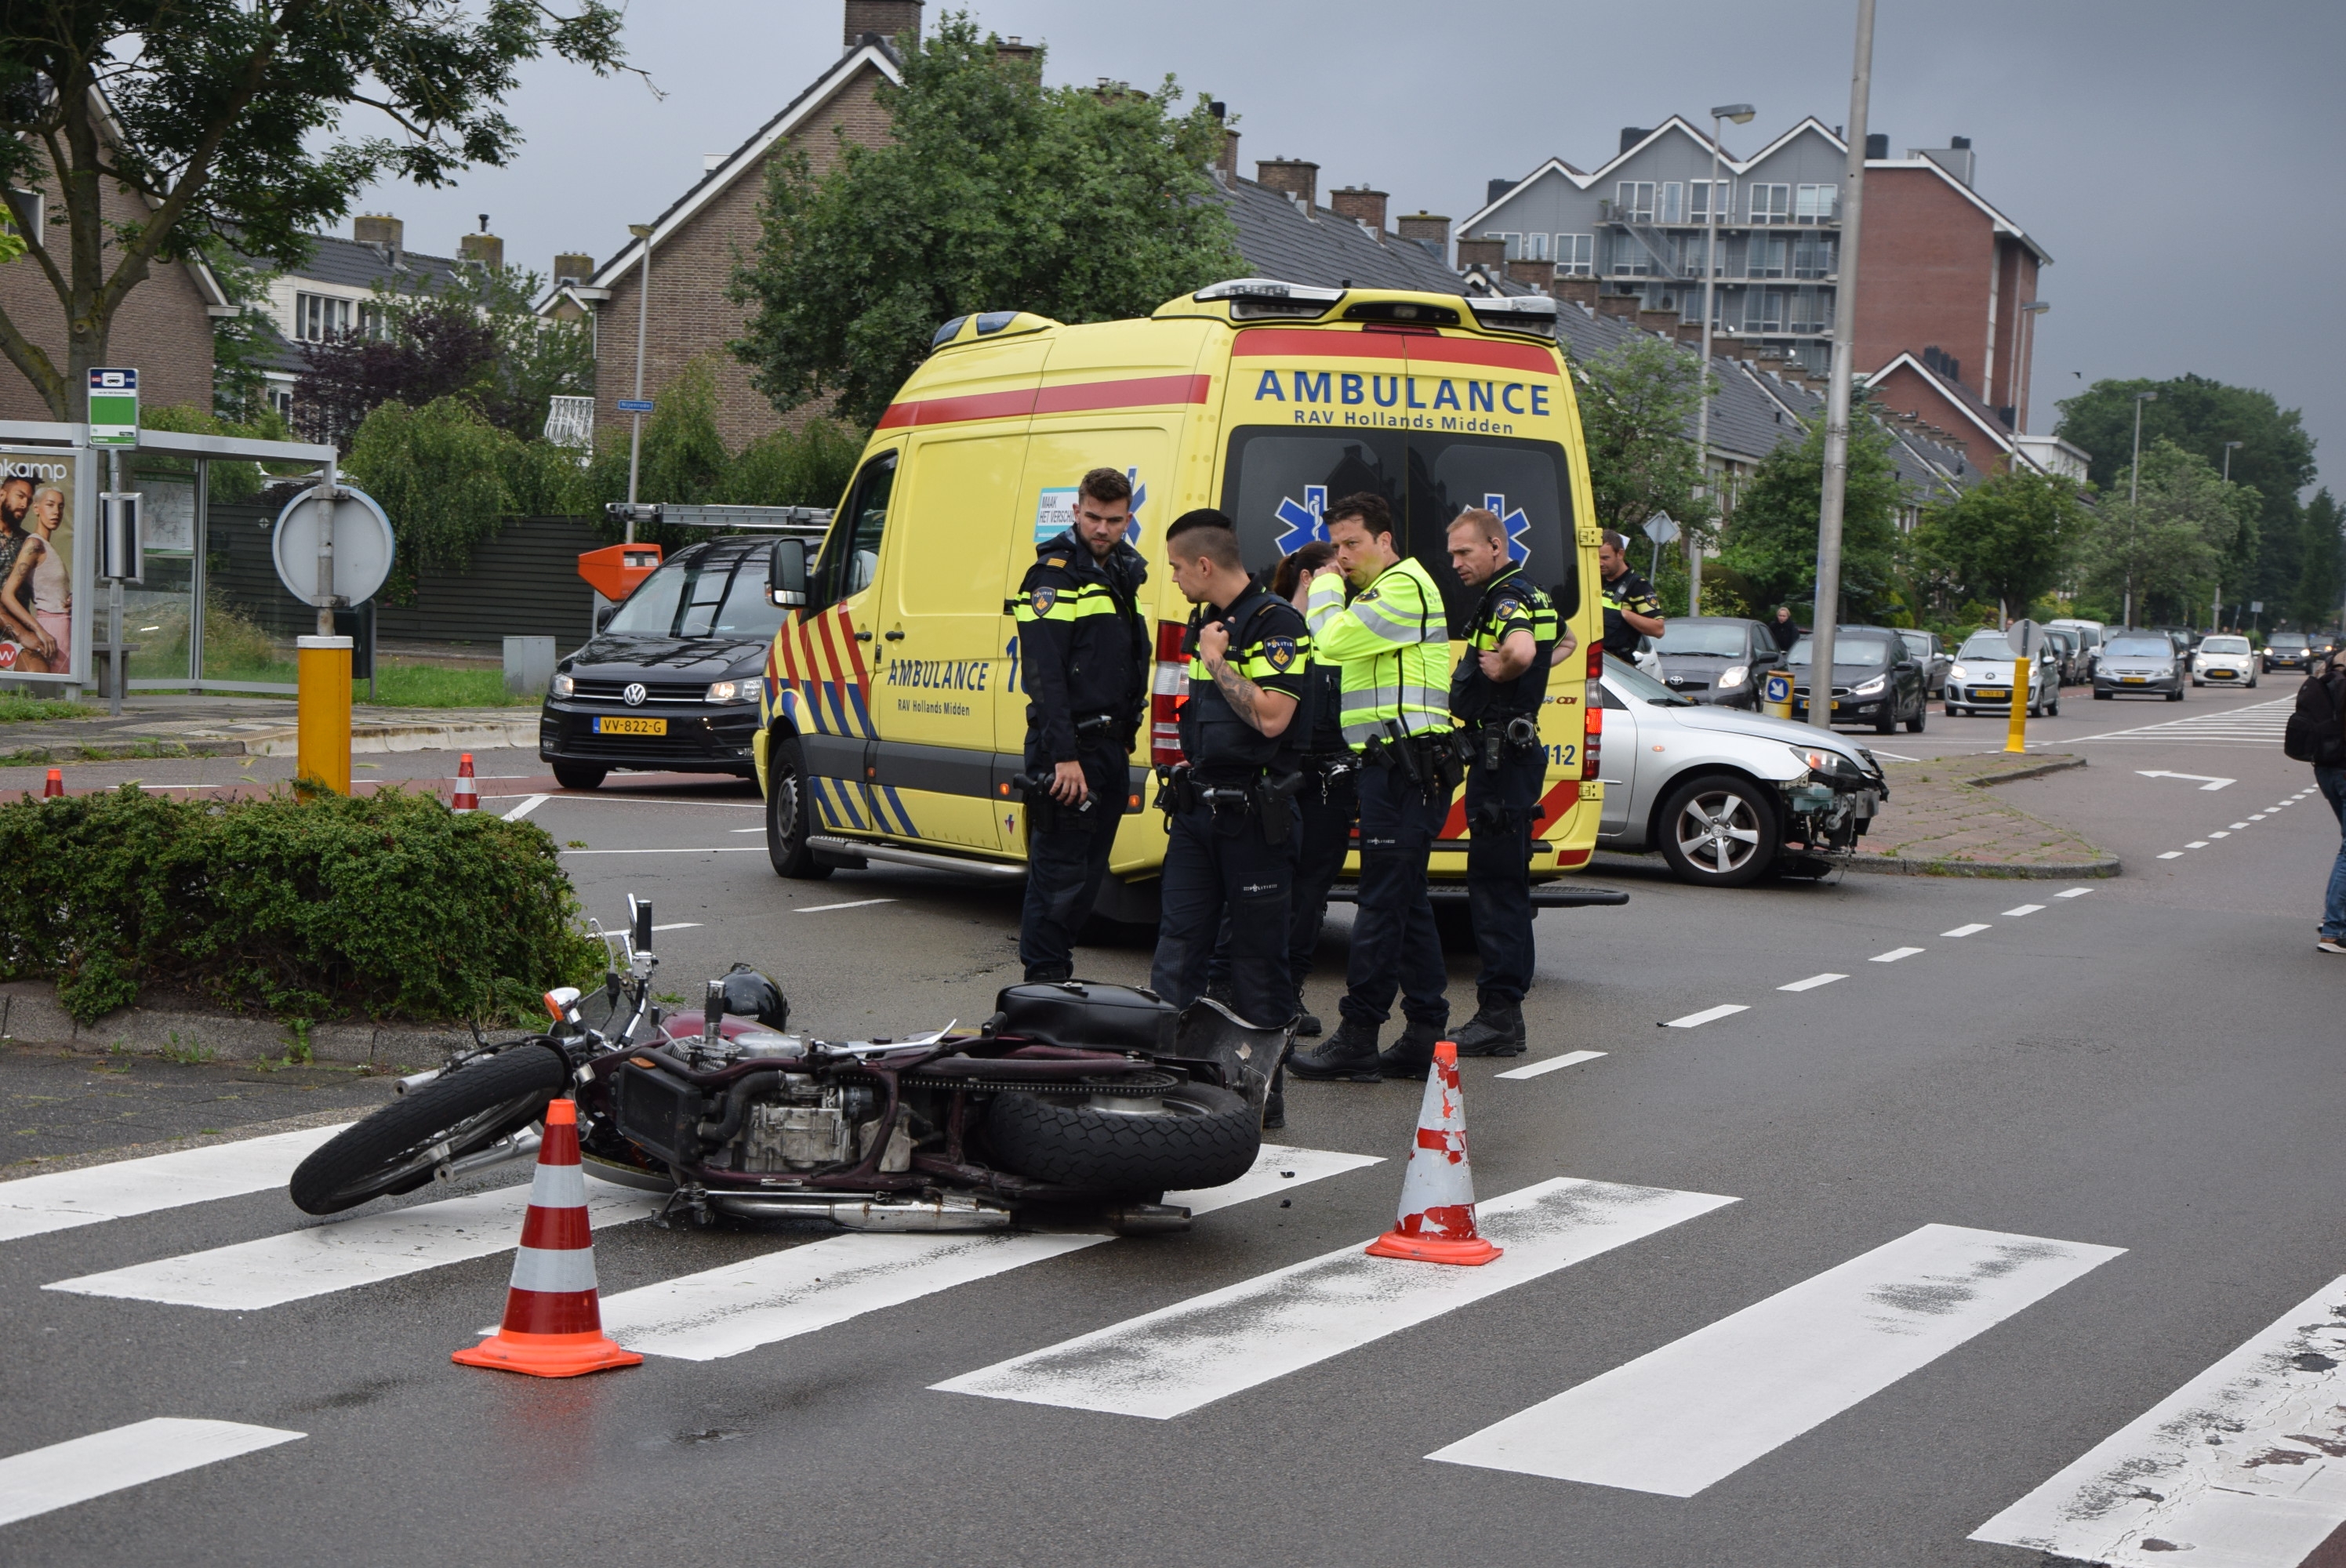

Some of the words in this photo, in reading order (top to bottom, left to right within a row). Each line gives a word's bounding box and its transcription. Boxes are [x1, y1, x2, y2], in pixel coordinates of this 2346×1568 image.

[1255, 369, 1550, 416] AMBULANCE
[1295, 410, 1335, 424] RAV
[1345, 411, 1434, 429] Hollands
[1441, 416, 1513, 434] Midden
[1041, 495, 1059, 509] MAAK
[1039, 511, 1051, 523] HET
[1267, 640, 1293, 648] POLITIE
[887, 659, 990, 691] AMBULANCE
[1556, 696, 1578, 705] CDI
[898, 699, 910, 711] RAV
[913, 700, 942, 714] Hollands
[943, 702, 970, 717] Midden
[604, 720, 662, 733] VV-822-G
